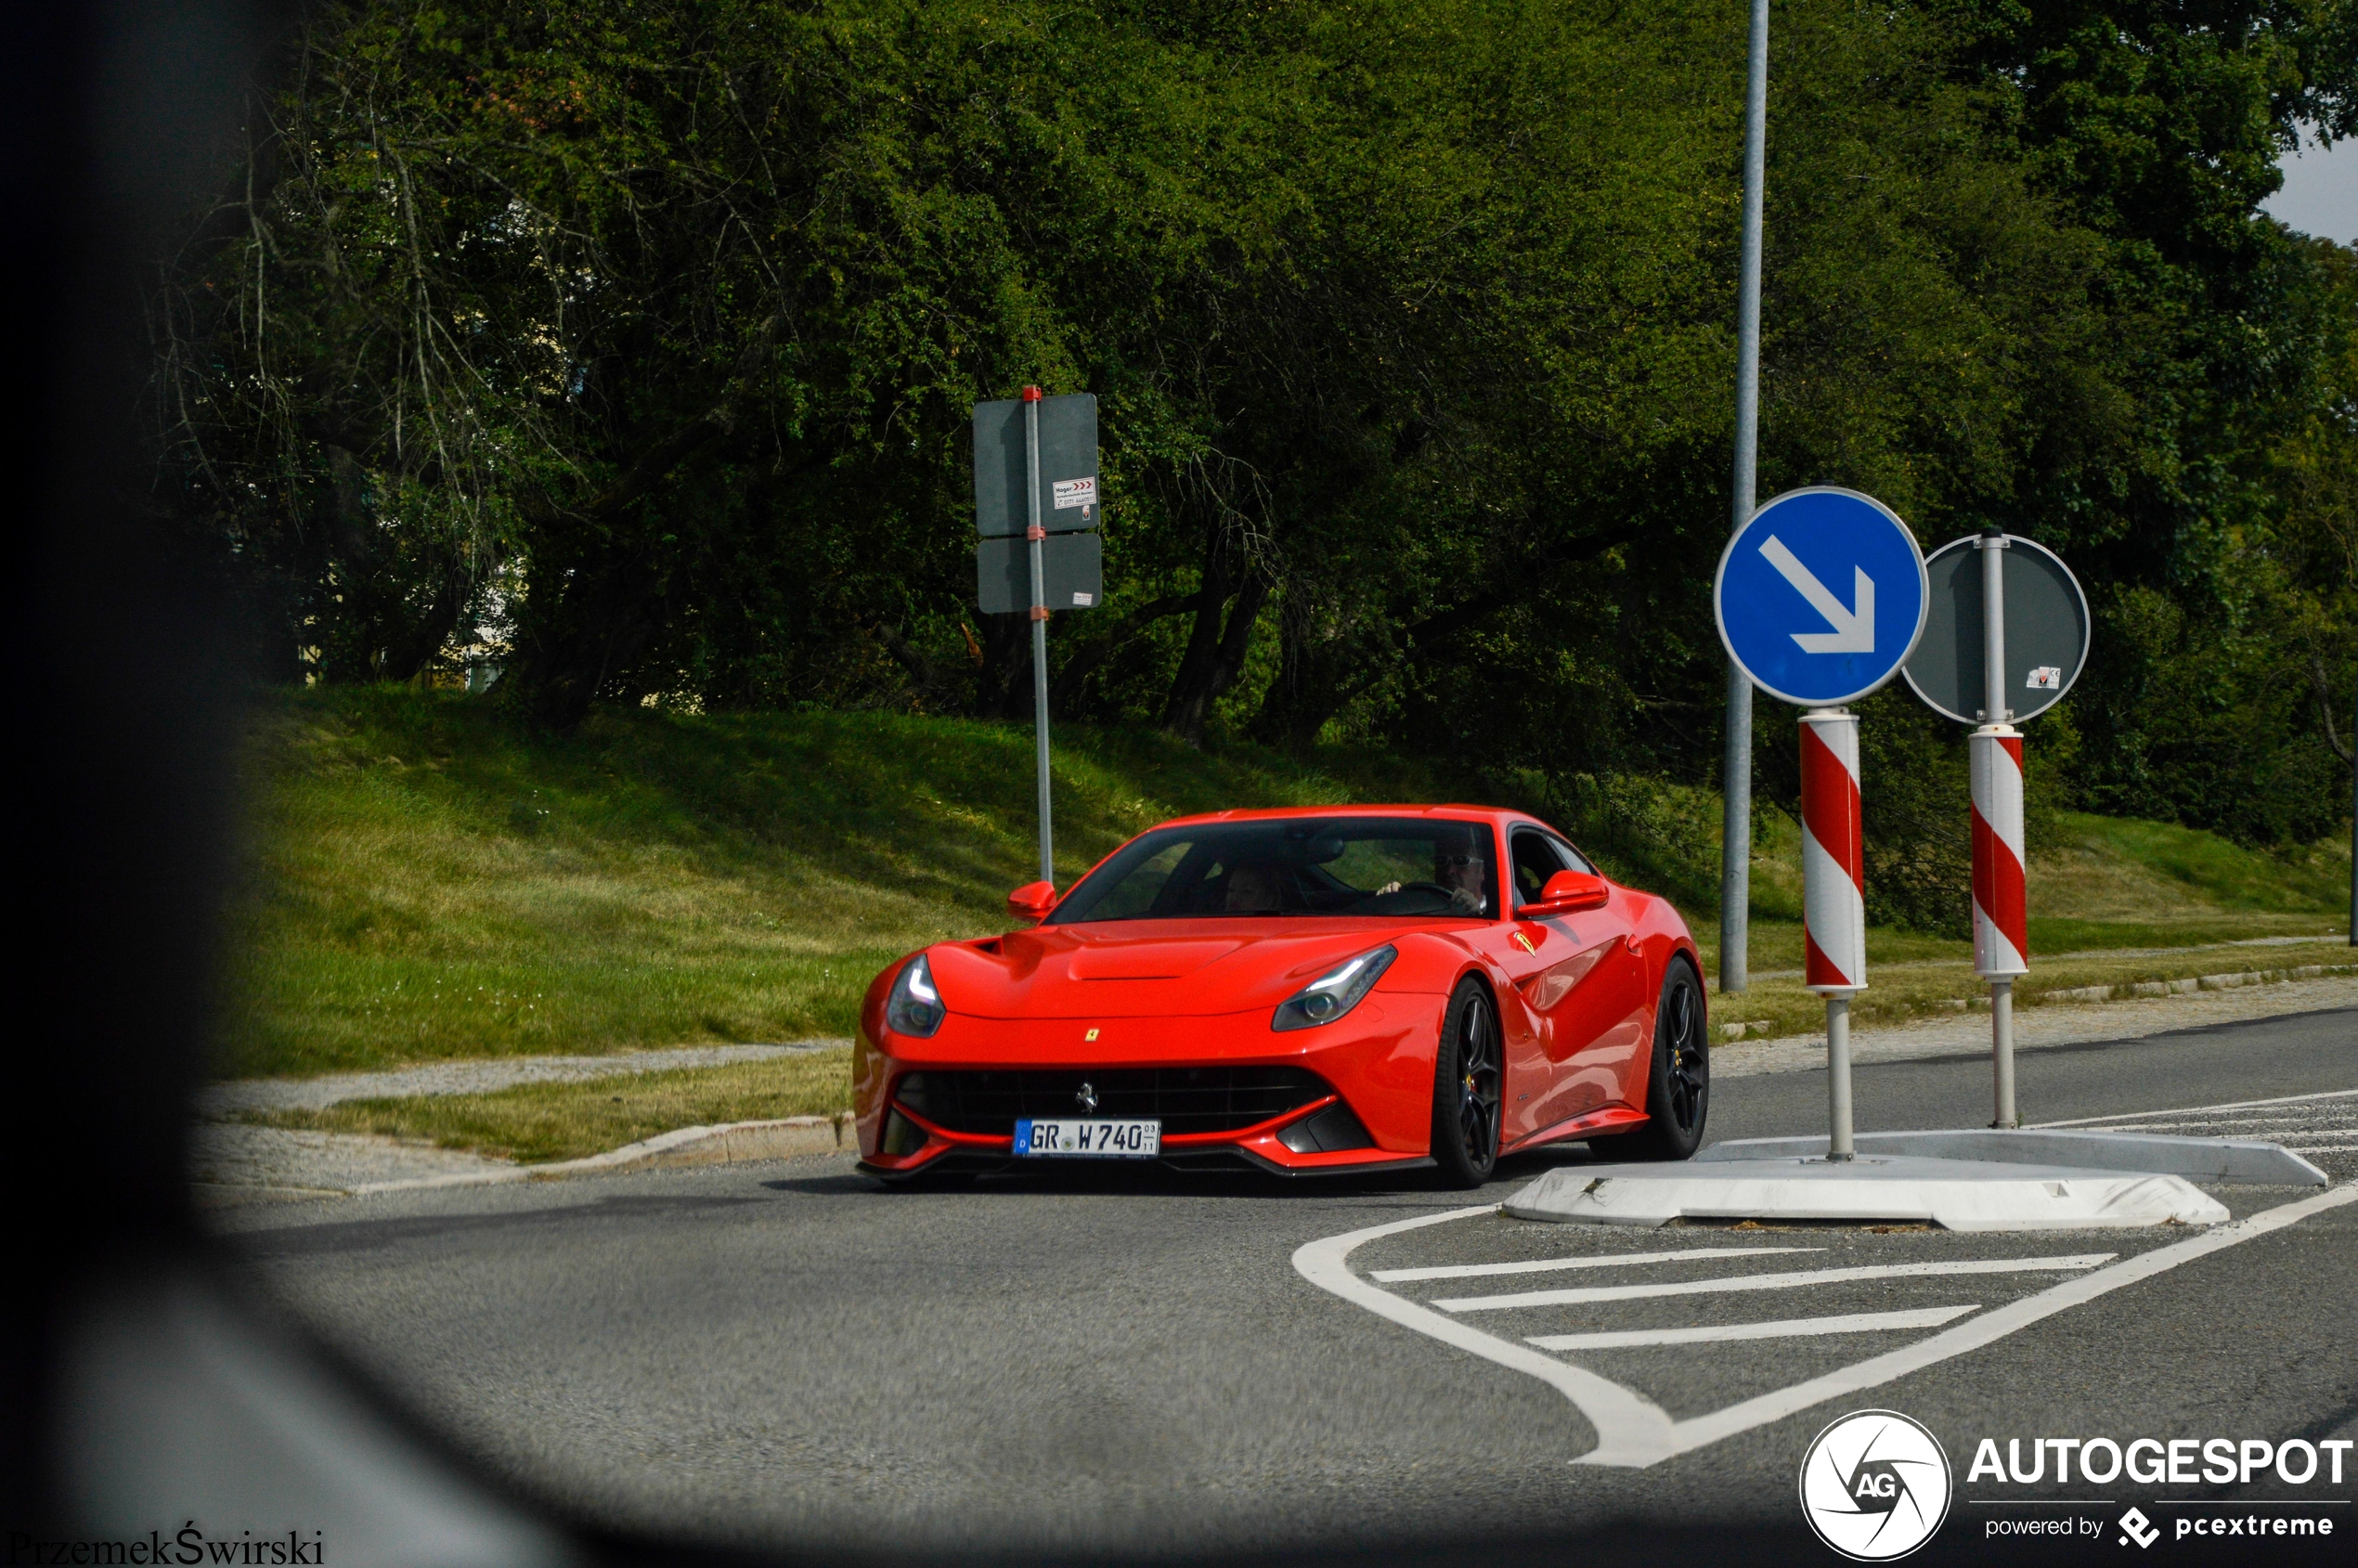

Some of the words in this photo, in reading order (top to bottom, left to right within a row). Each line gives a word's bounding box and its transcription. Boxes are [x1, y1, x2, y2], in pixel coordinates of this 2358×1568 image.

[1030, 1124, 1059, 1149] GR
[1078, 1124, 1093, 1150] W
[1098, 1124, 1143, 1150] 740
[1145, 1124, 1156, 1133] 03
